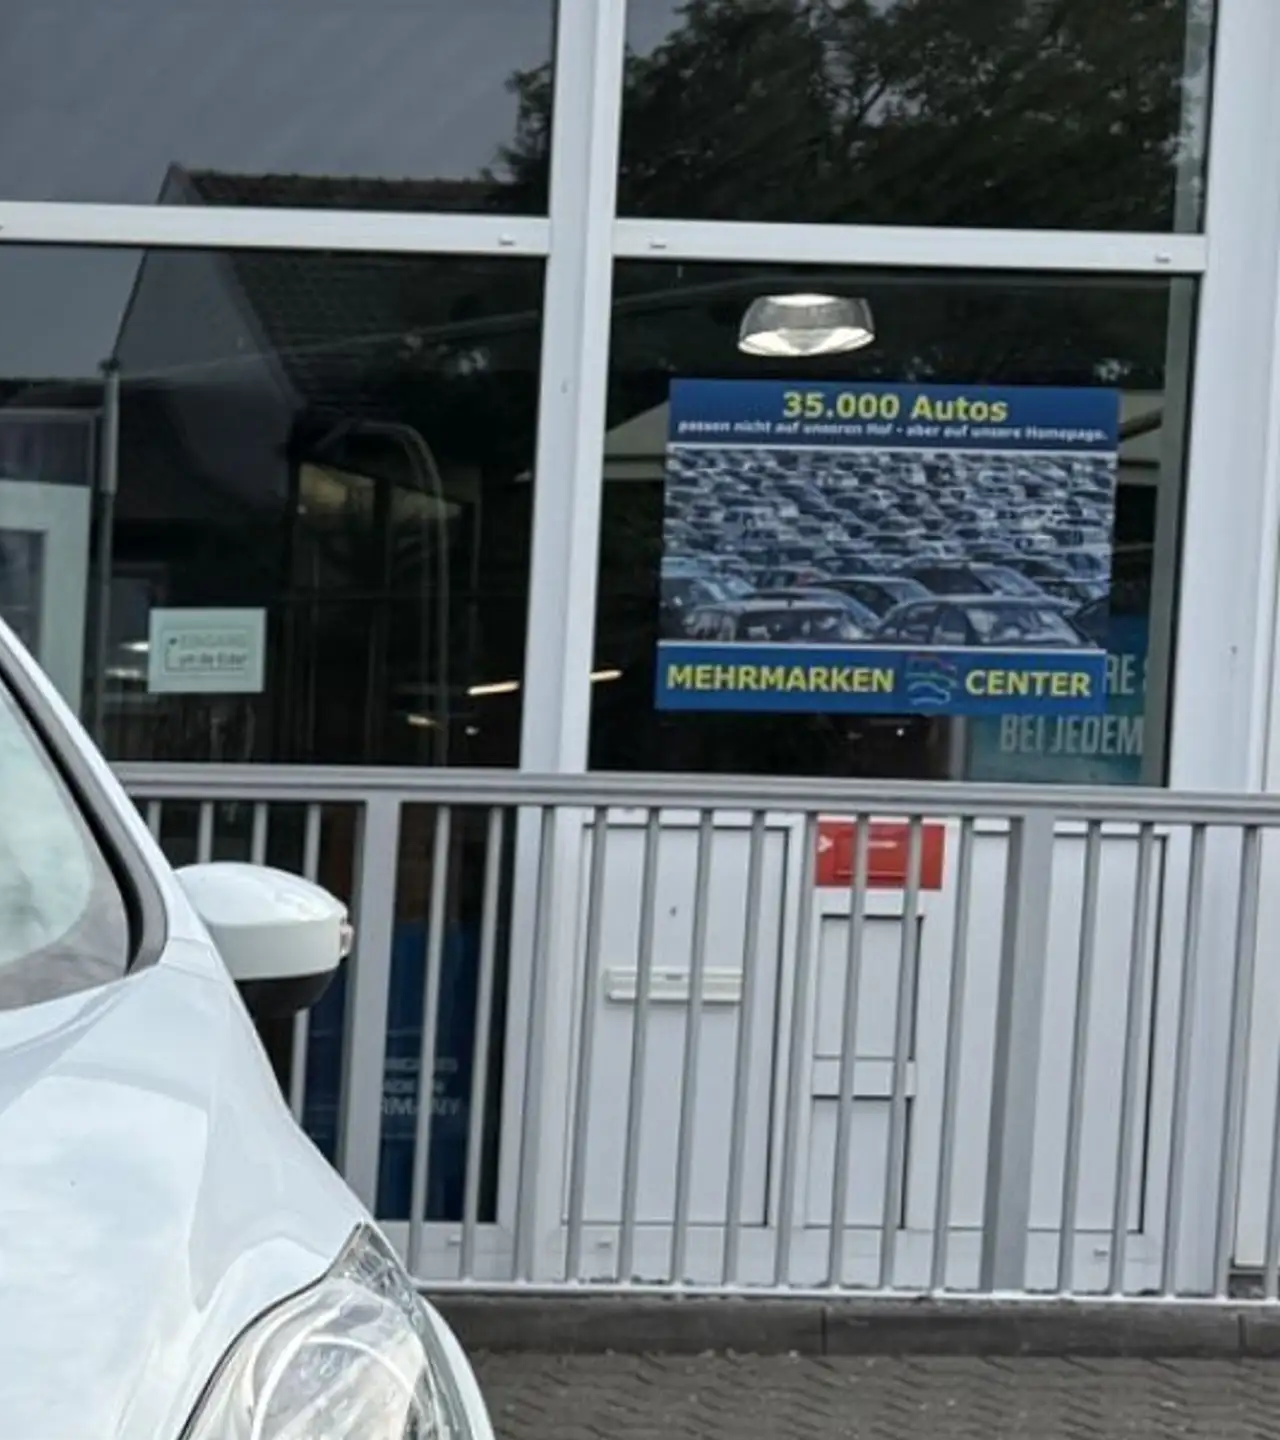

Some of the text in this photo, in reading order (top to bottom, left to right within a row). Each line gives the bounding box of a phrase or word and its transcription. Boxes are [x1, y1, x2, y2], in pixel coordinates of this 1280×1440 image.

[783, 391, 1009, 423] 35.000 Autos
[666, 664, 1092, 698] MEHRMARKEN CENTER
